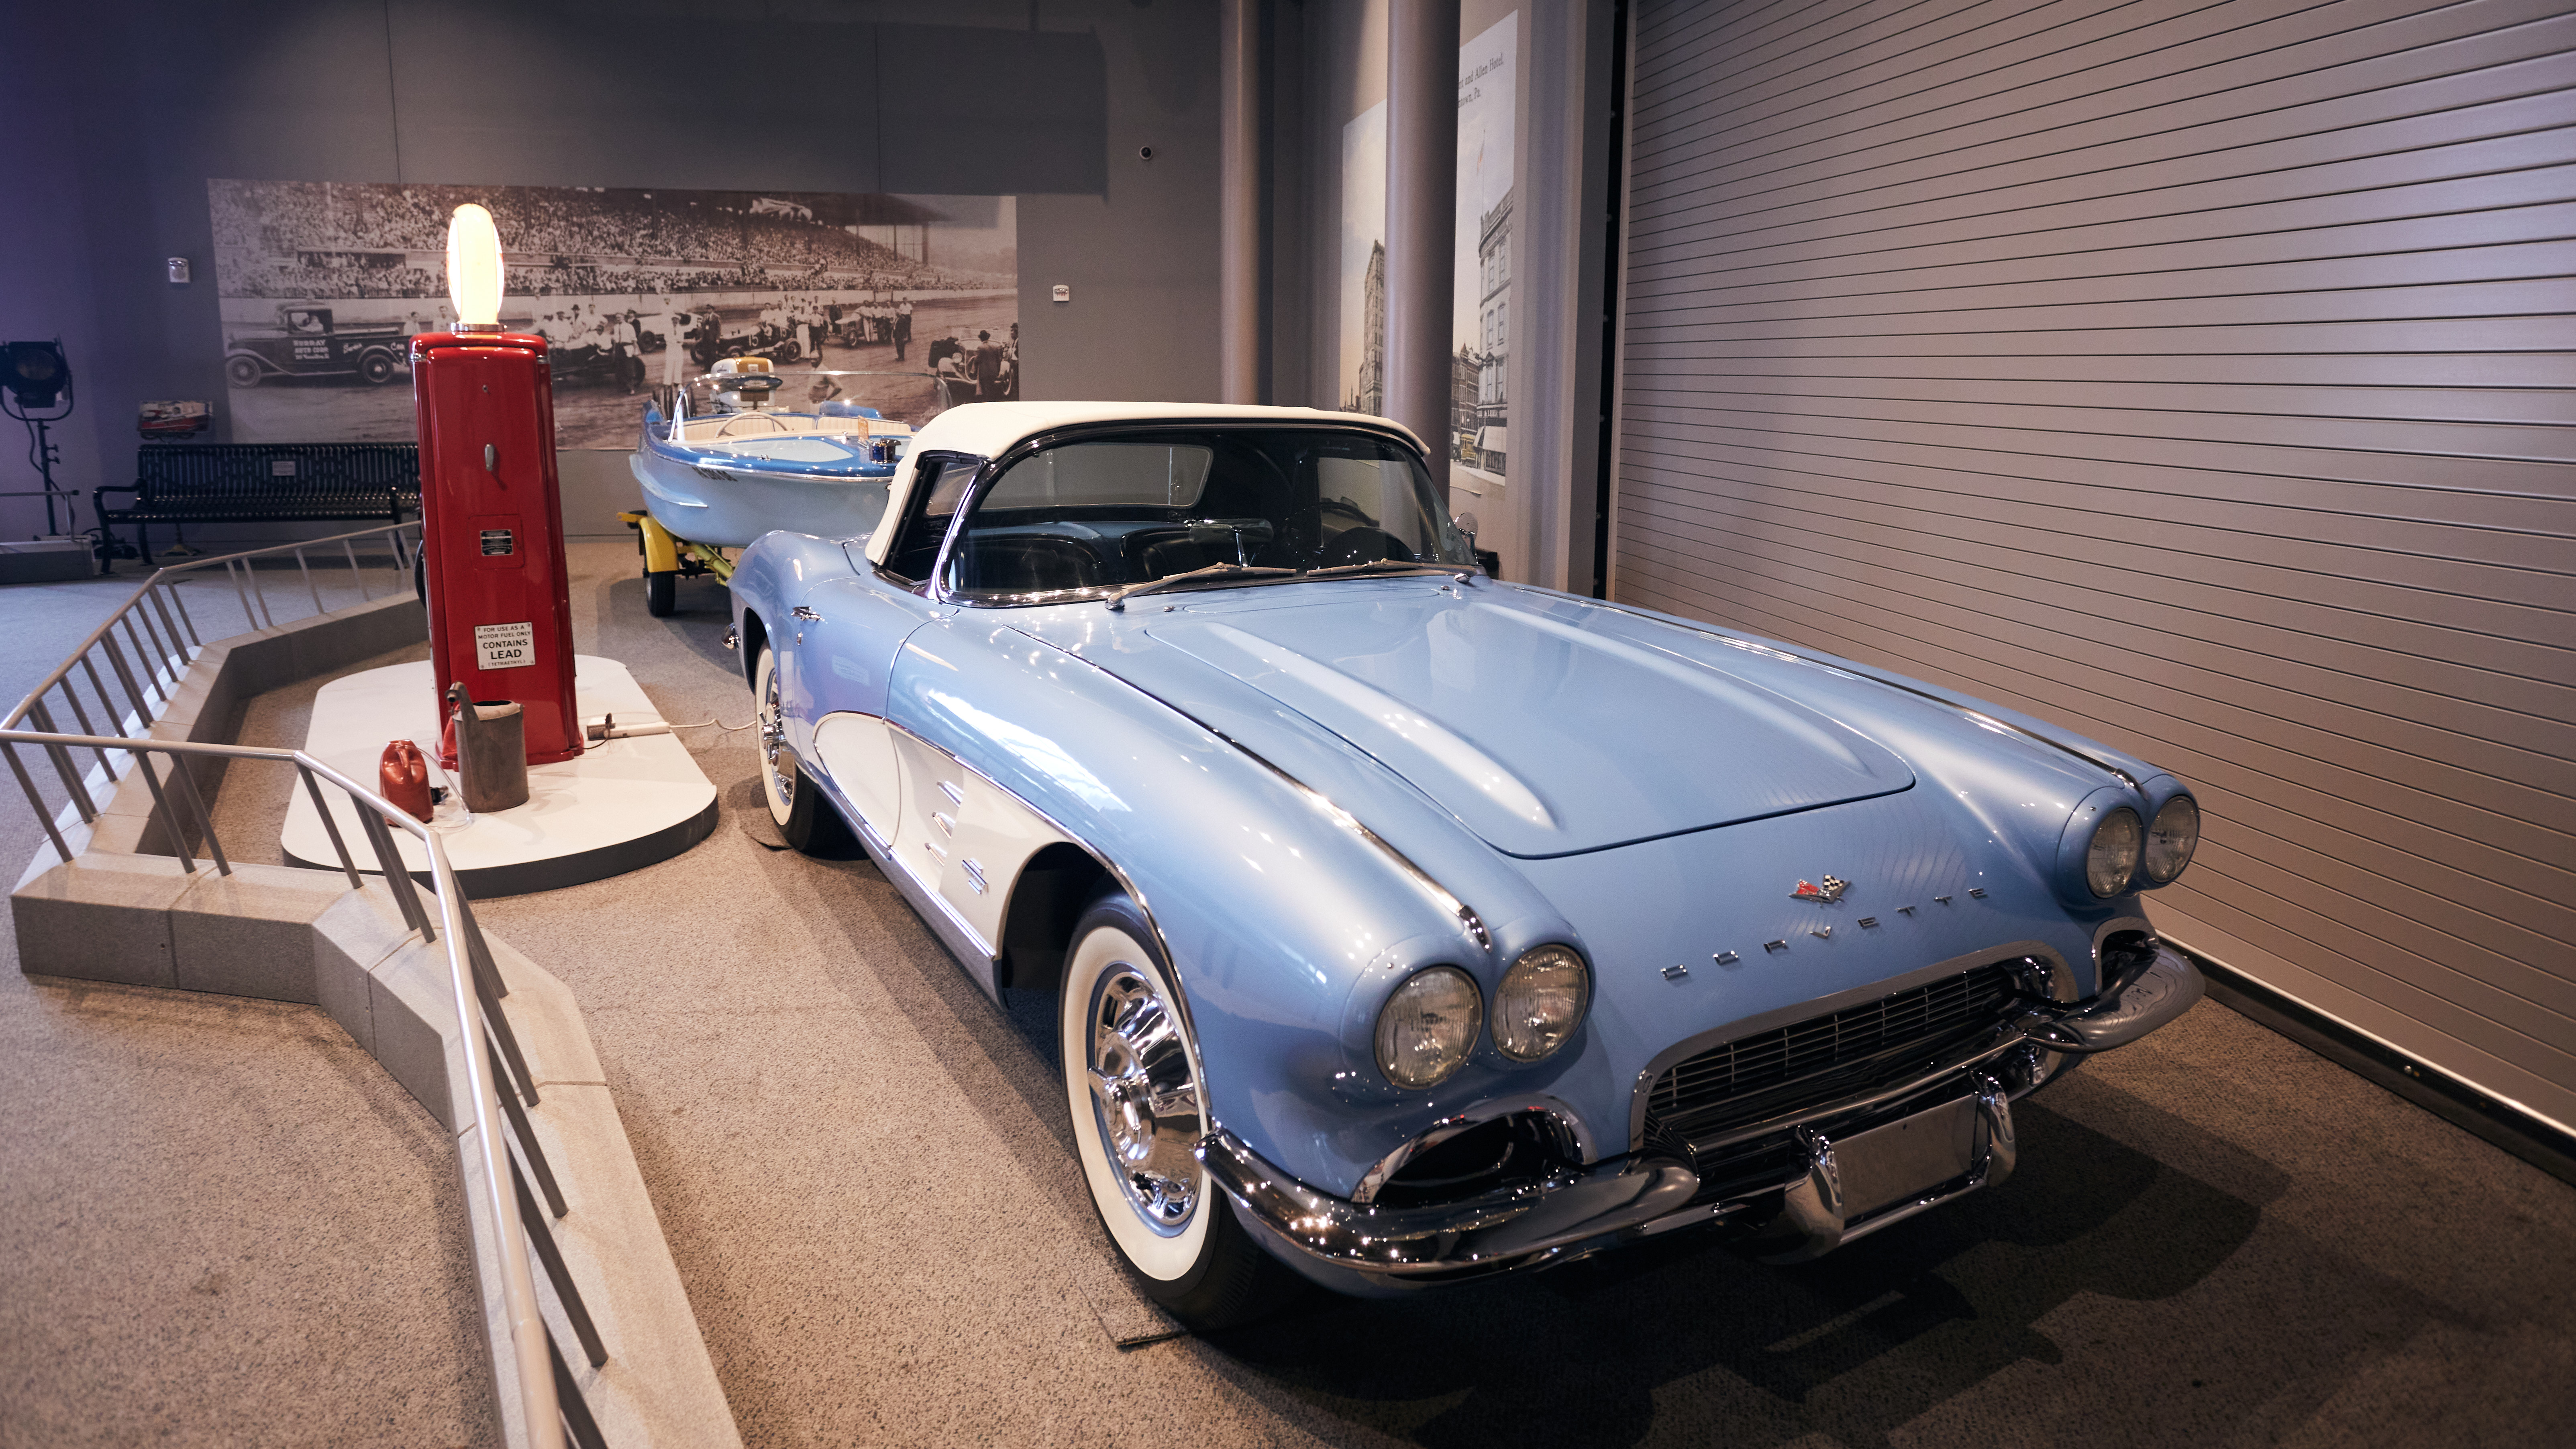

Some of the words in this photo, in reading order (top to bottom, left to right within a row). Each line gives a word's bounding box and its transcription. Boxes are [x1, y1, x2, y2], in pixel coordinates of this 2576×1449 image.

[1465, 70, 1473, 86] and
[1475, 65, 1487, 79] Allen
[749, 334, 759, 346] 15
[483, 639, 528, 649] CONTAINS
[491, 649, 522, 659] LEAD
